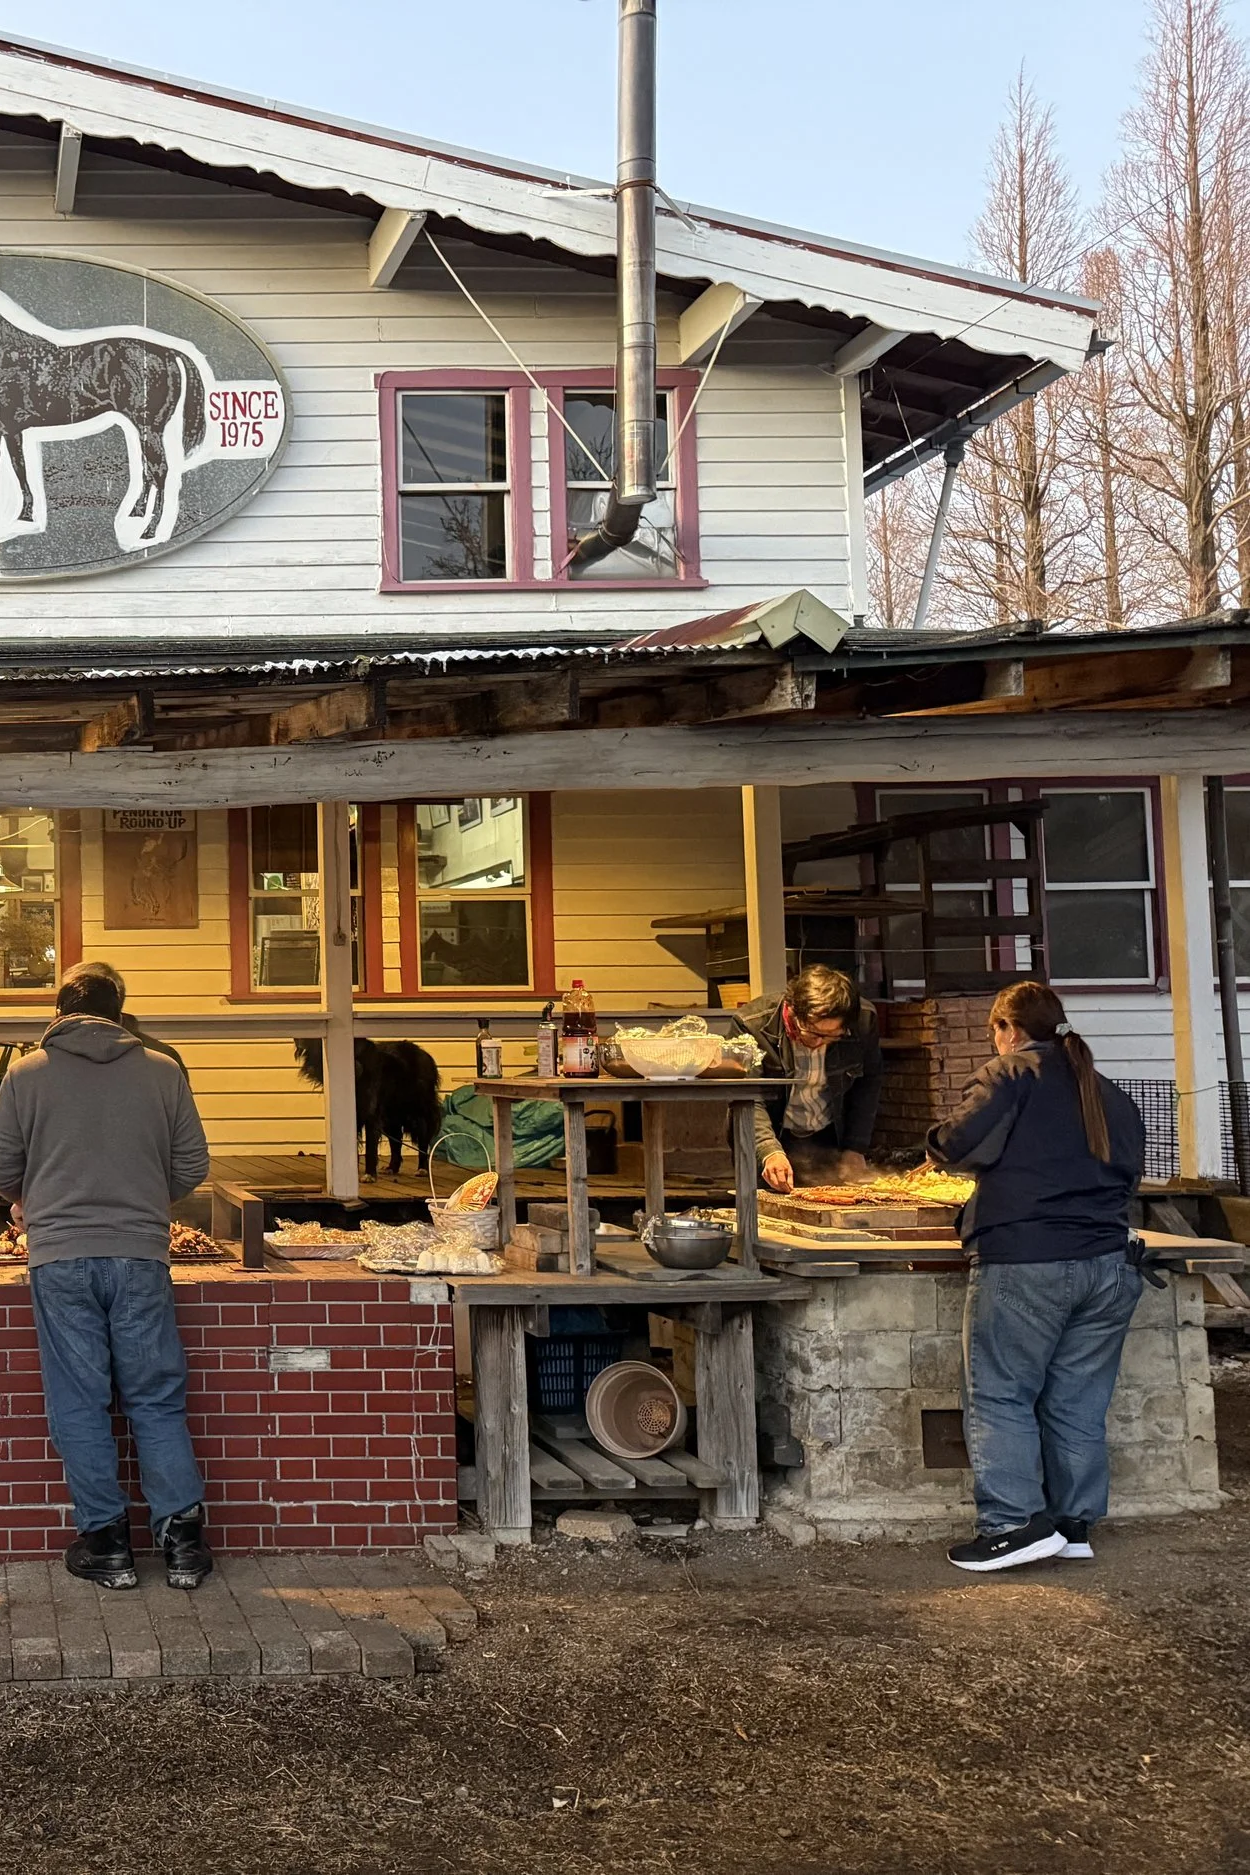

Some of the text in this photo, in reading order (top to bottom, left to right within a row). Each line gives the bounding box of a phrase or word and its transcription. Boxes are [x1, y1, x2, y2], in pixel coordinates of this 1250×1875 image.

[209, 390, 279, 421] SINCE
[220, 421, 264, 448] 1975
[112, 809, 182, 819] PENDLETON
